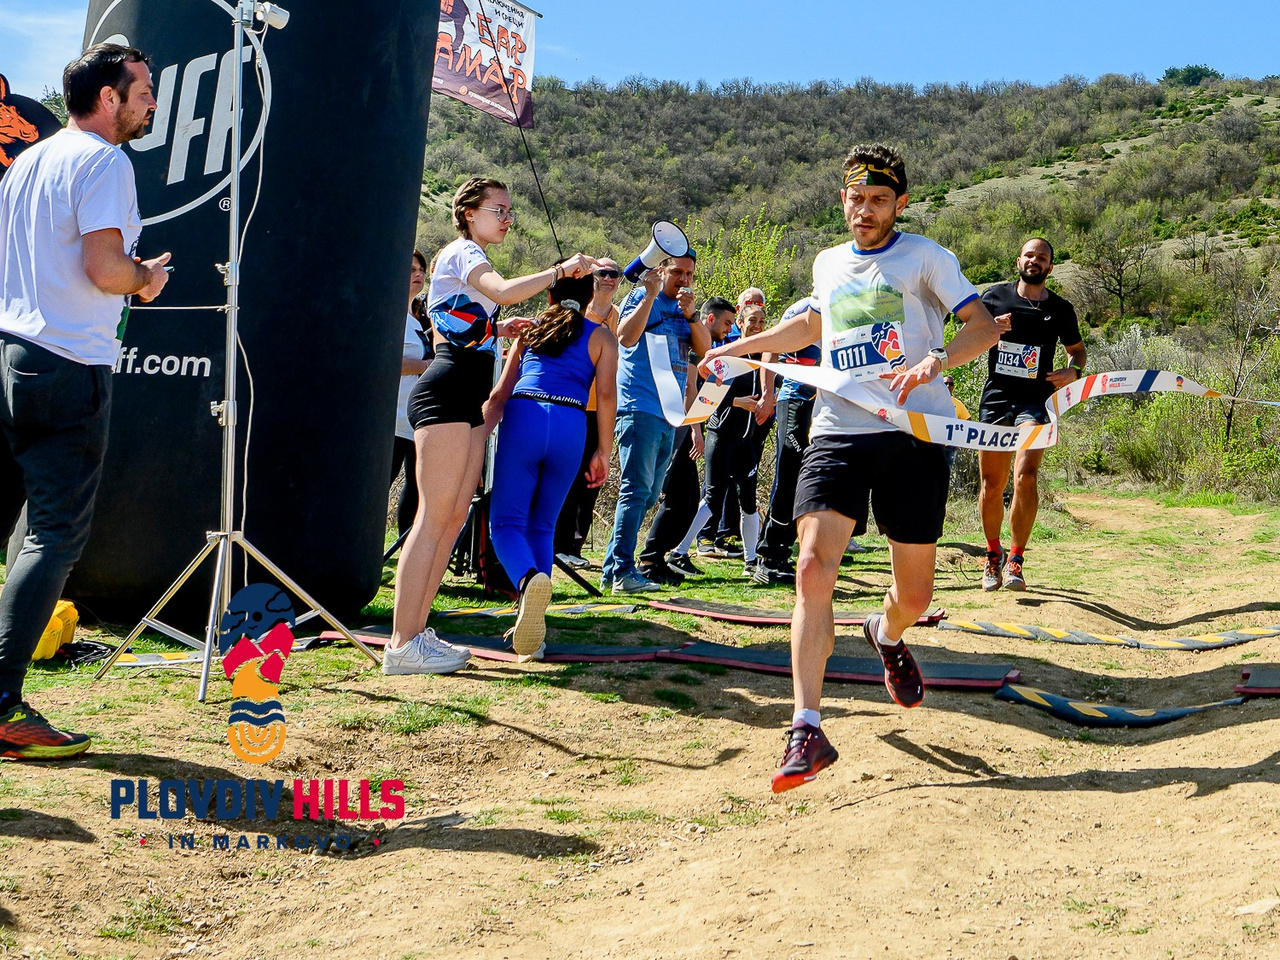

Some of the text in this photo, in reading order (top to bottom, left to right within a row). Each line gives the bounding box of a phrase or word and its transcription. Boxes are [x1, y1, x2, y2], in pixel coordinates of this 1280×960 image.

[837, 345, 867, 370] 0111
[998, 352, 1020, 367] 0134
[966, 428, 1019, 447] PLACE
